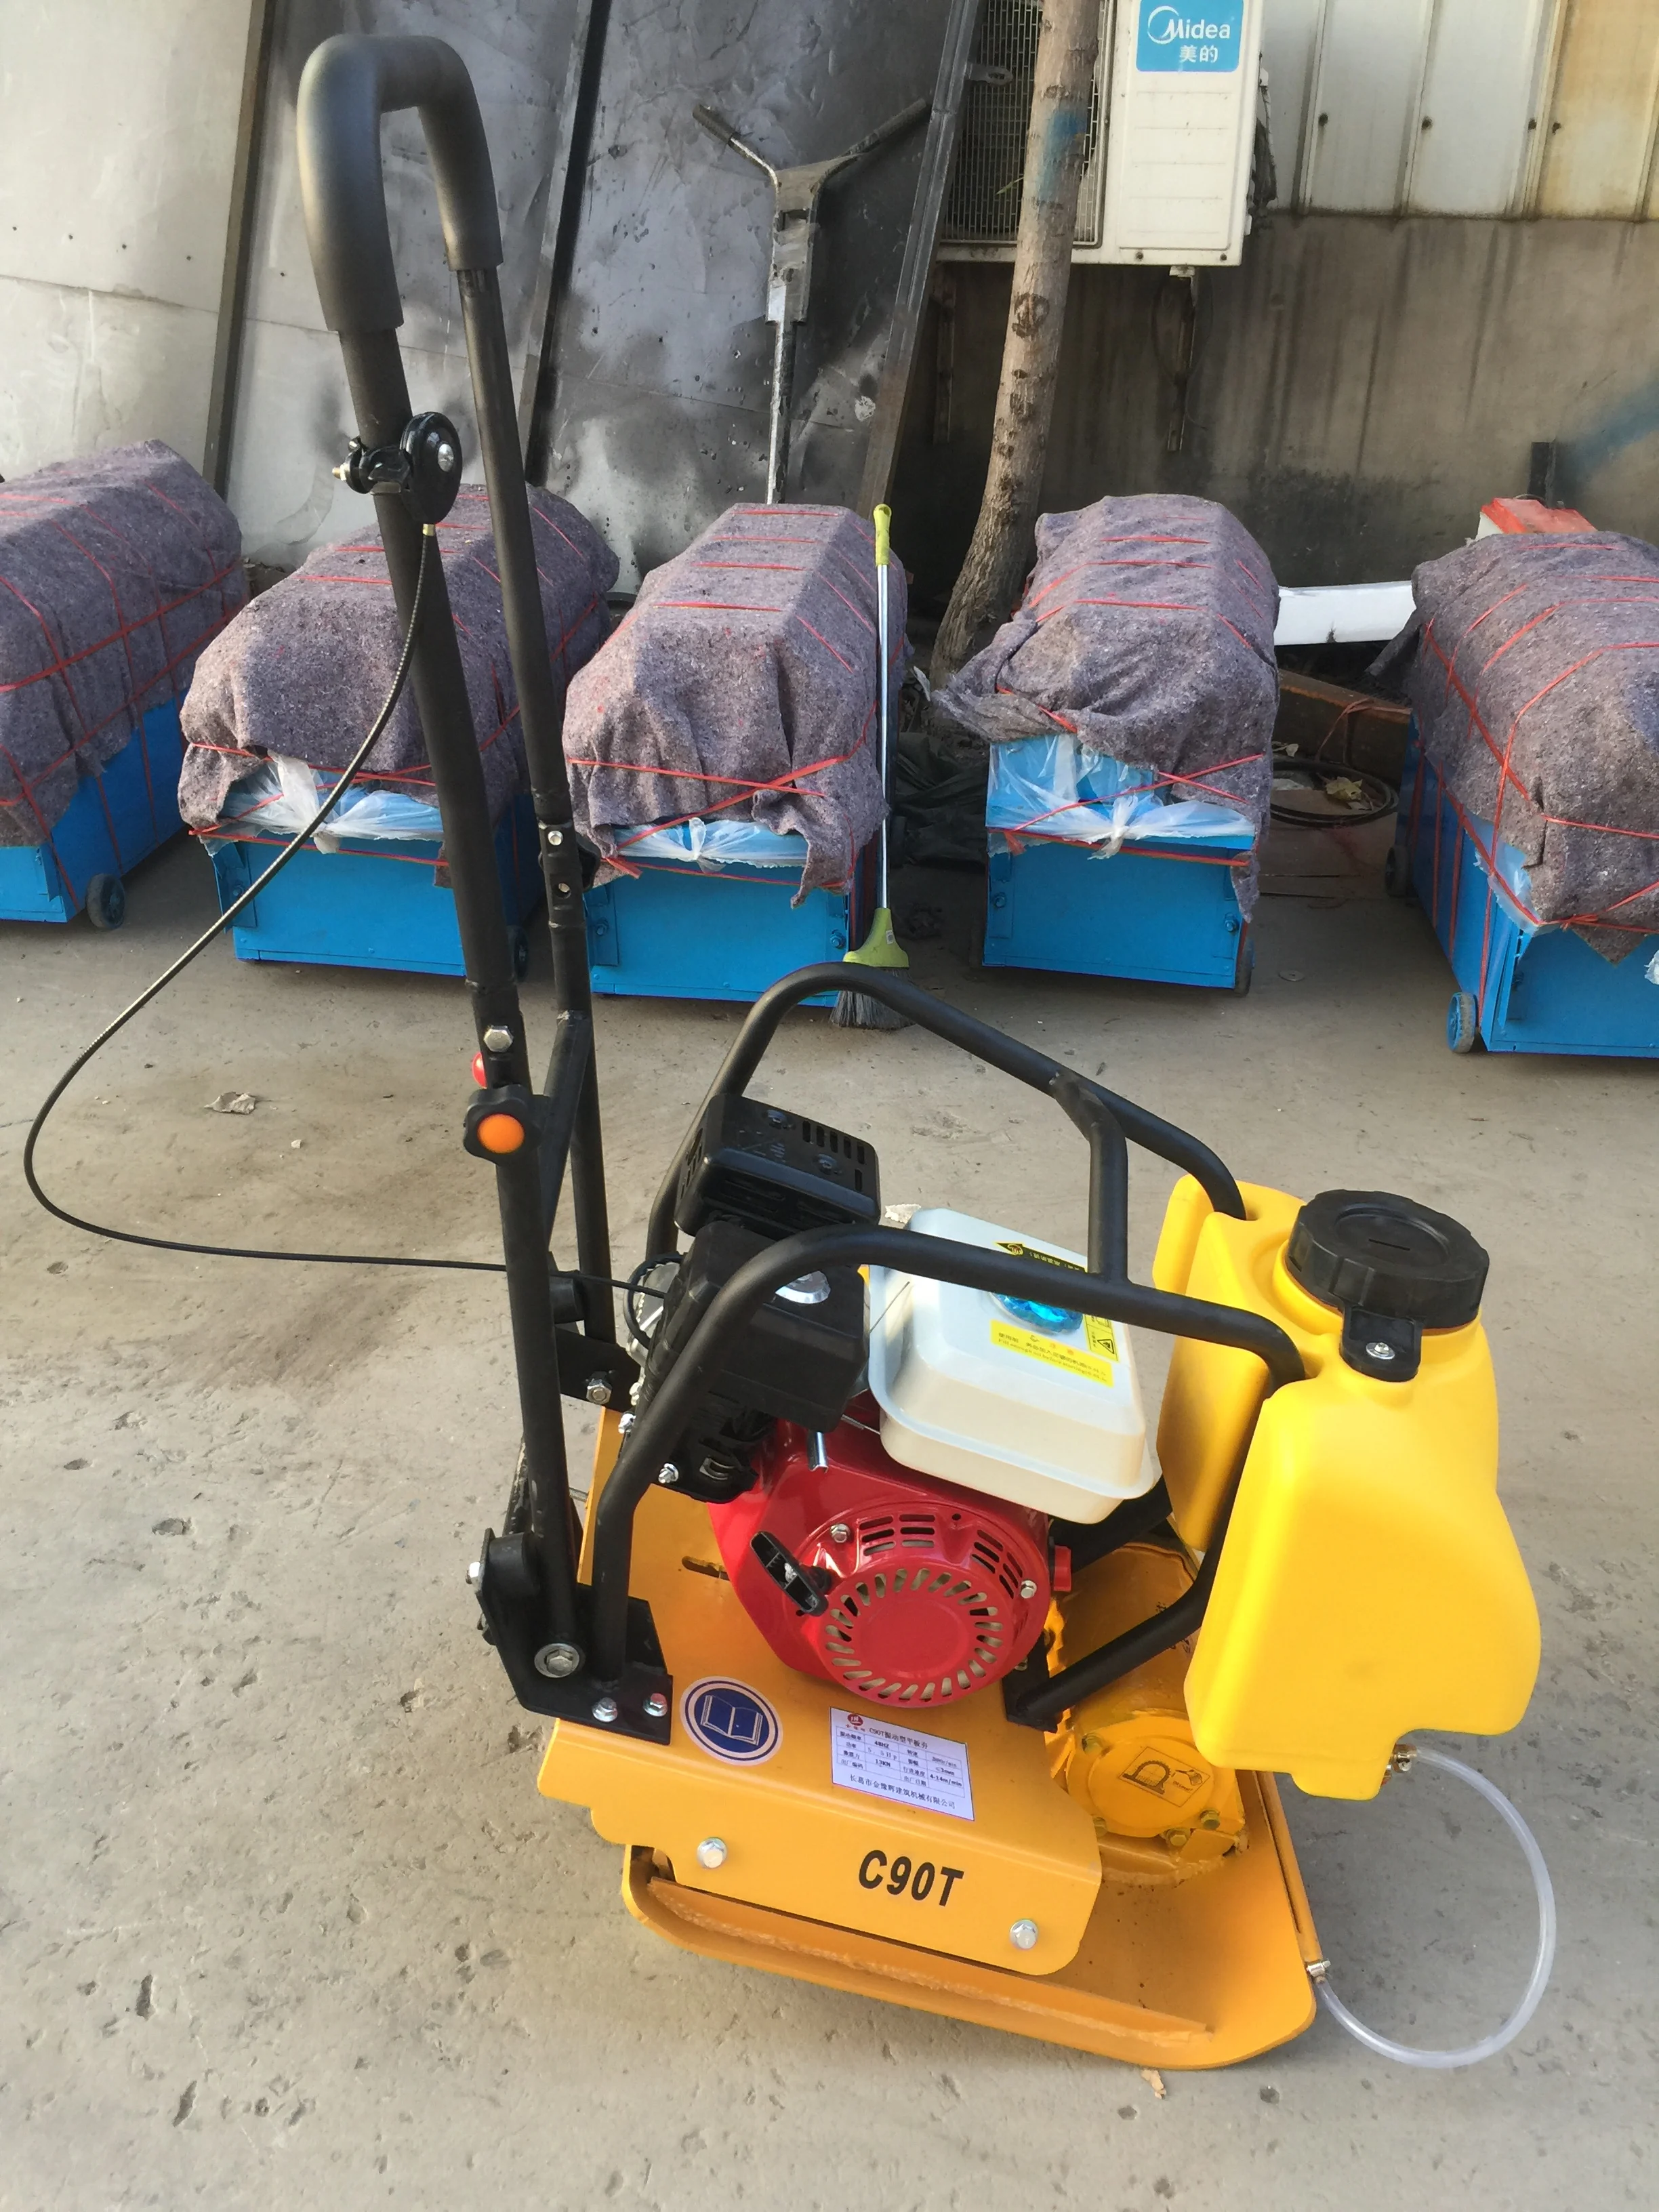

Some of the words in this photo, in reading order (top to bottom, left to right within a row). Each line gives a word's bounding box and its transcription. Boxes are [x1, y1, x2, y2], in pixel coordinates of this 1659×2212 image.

[1148, 15, 1230, 42] Midea
[1179, 45, 1218, 63] 美的
[859, 1849, 964, 1907] C90T
